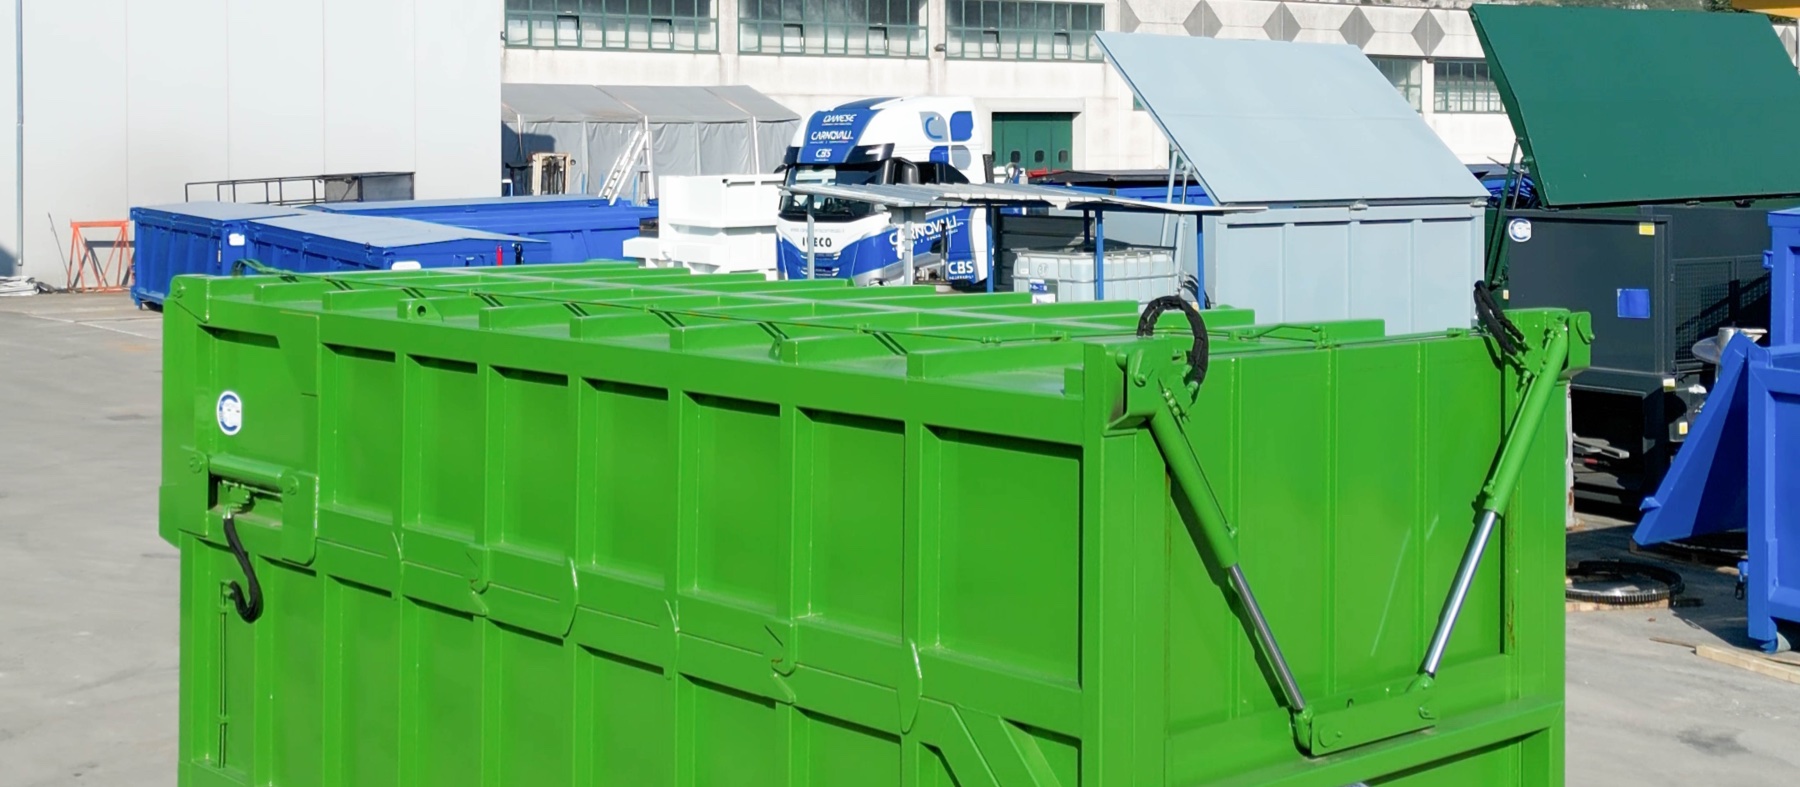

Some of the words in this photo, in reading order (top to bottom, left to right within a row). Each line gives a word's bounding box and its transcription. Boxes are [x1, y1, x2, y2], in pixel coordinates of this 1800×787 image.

[888, 215, 957, 246] CRNOVALI
[802, 236, 832, 248] IECO
[948, 261, 974, 275] CBS
